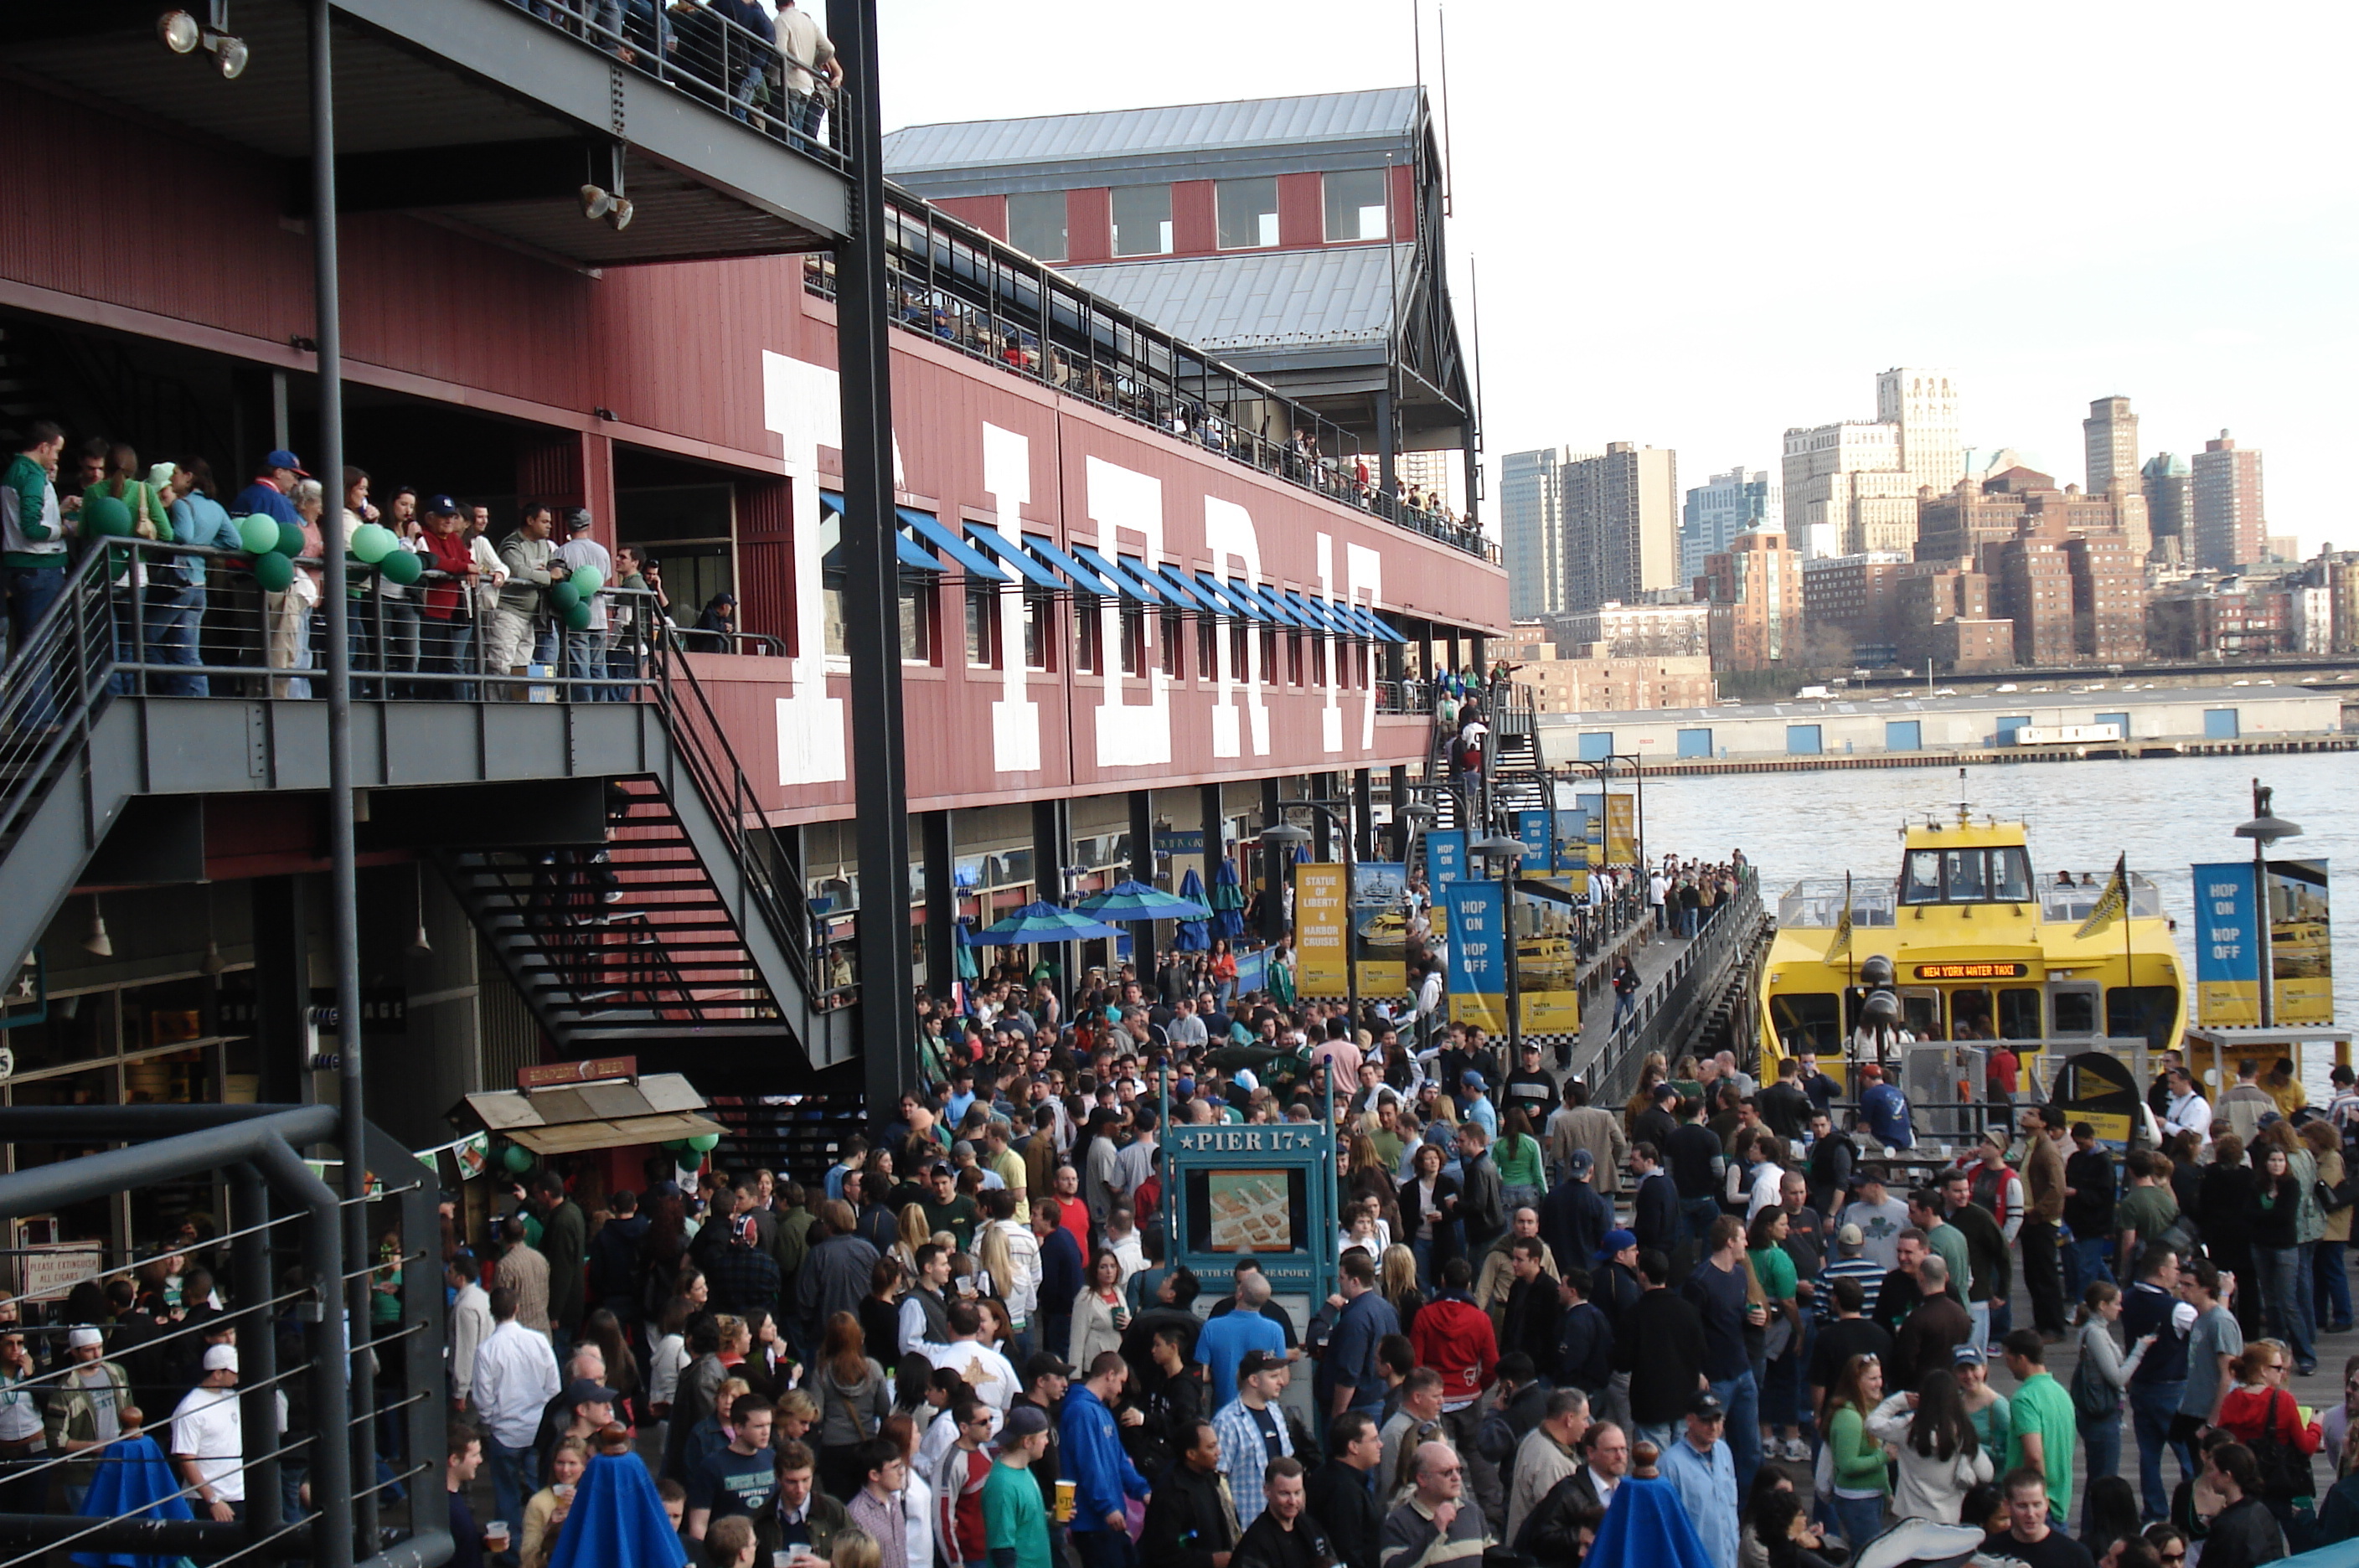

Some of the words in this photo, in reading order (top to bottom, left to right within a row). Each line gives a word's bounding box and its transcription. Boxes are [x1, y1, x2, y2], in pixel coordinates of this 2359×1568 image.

[1316, 530, 1383, 753] 17
[1437, 844, 1454, 854] HOP
[1441, 856, 1453, 865] ON
[1305, 876, 1336, 886] STATUE
[1439, 872, 1456, 881] HOP
[1315, 887, 1327, 896] OF
[2209, 884, 2238, 897] HOP
[1303, 898, 1338, 907] LIBERTY
[1461, 901, 1487, 914] HOP
[2216, 902, 2234, 915] ON
[1319, 912, 1326, 921] &
[1303, 926, 1339, 935] HARBOR
[1466, 918, 1483, 931] ON
[2212, 928, 2240, 941] HOP
[1303, 936, 1340, 946] CRUISES
[1463, 943, 1488, 956] HOP
[2212, 946, 2241, 959] OFF
[1463, 960, 1488, 972] OFF
[1923, 967, 1940, 977] NEW
[1942, 966, 1964, 977] YORK
[1966, 965, 1992, 976] WATER
[1994, 965, 2014, 976] TAXI
[1196, 1132, 1262, 1151] PIER
[1270, 1132, 1294, 1150] 17
[30, 1262, 54, 1271] PLEASE
[58, 1259, 96, 1270] EXTINGUISH
[54, 1272, 79, 1282] CIGARS
[1190, 1269, 1221, 1277] OUTH
[1264, 1269, 1311, 1277] SEAPORT
